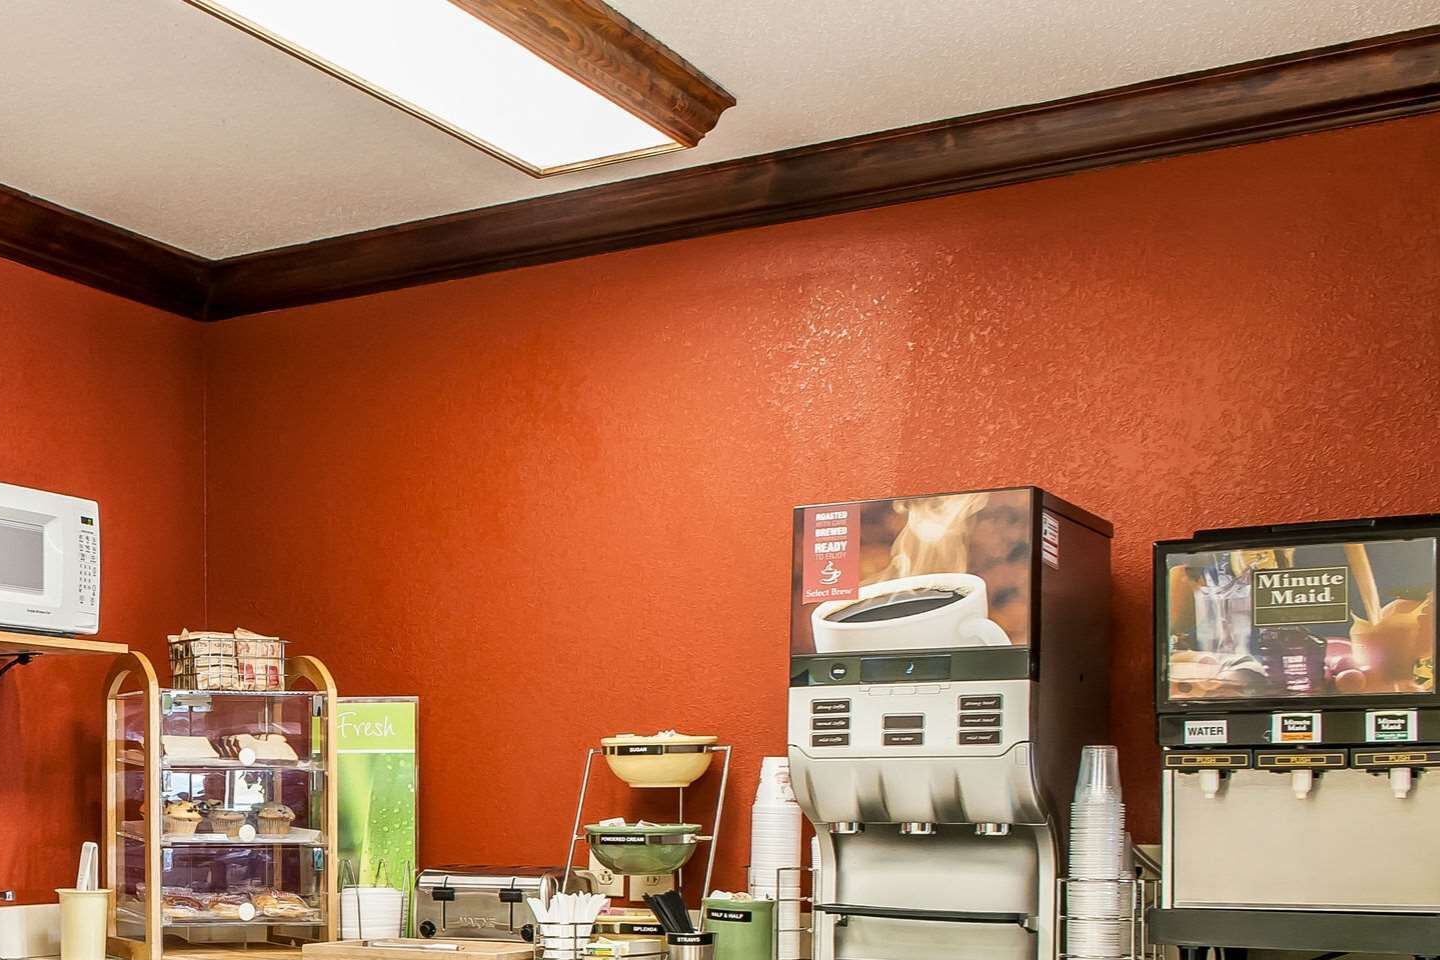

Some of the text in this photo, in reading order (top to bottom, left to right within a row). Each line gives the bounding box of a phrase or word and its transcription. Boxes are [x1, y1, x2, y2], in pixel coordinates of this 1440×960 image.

[816, 511, 848, 521] ROASTED
[815, 541, 848, 553] READY
[1258, 573, 1345, 590] Minute
[805, 589, 830, 598] Select
[1271, 587, 1332, 605] Maid
[337, 711, 396, 739] Fresh
[1377, 717, 1406, 725] Minute
[1187, 726, 1225, 737] WATER
[1196, 756, 1217, 764] PUSH
[1290, 756, 1312, 764] PUSH
[1388, 754, 1411, 762] PUSH
